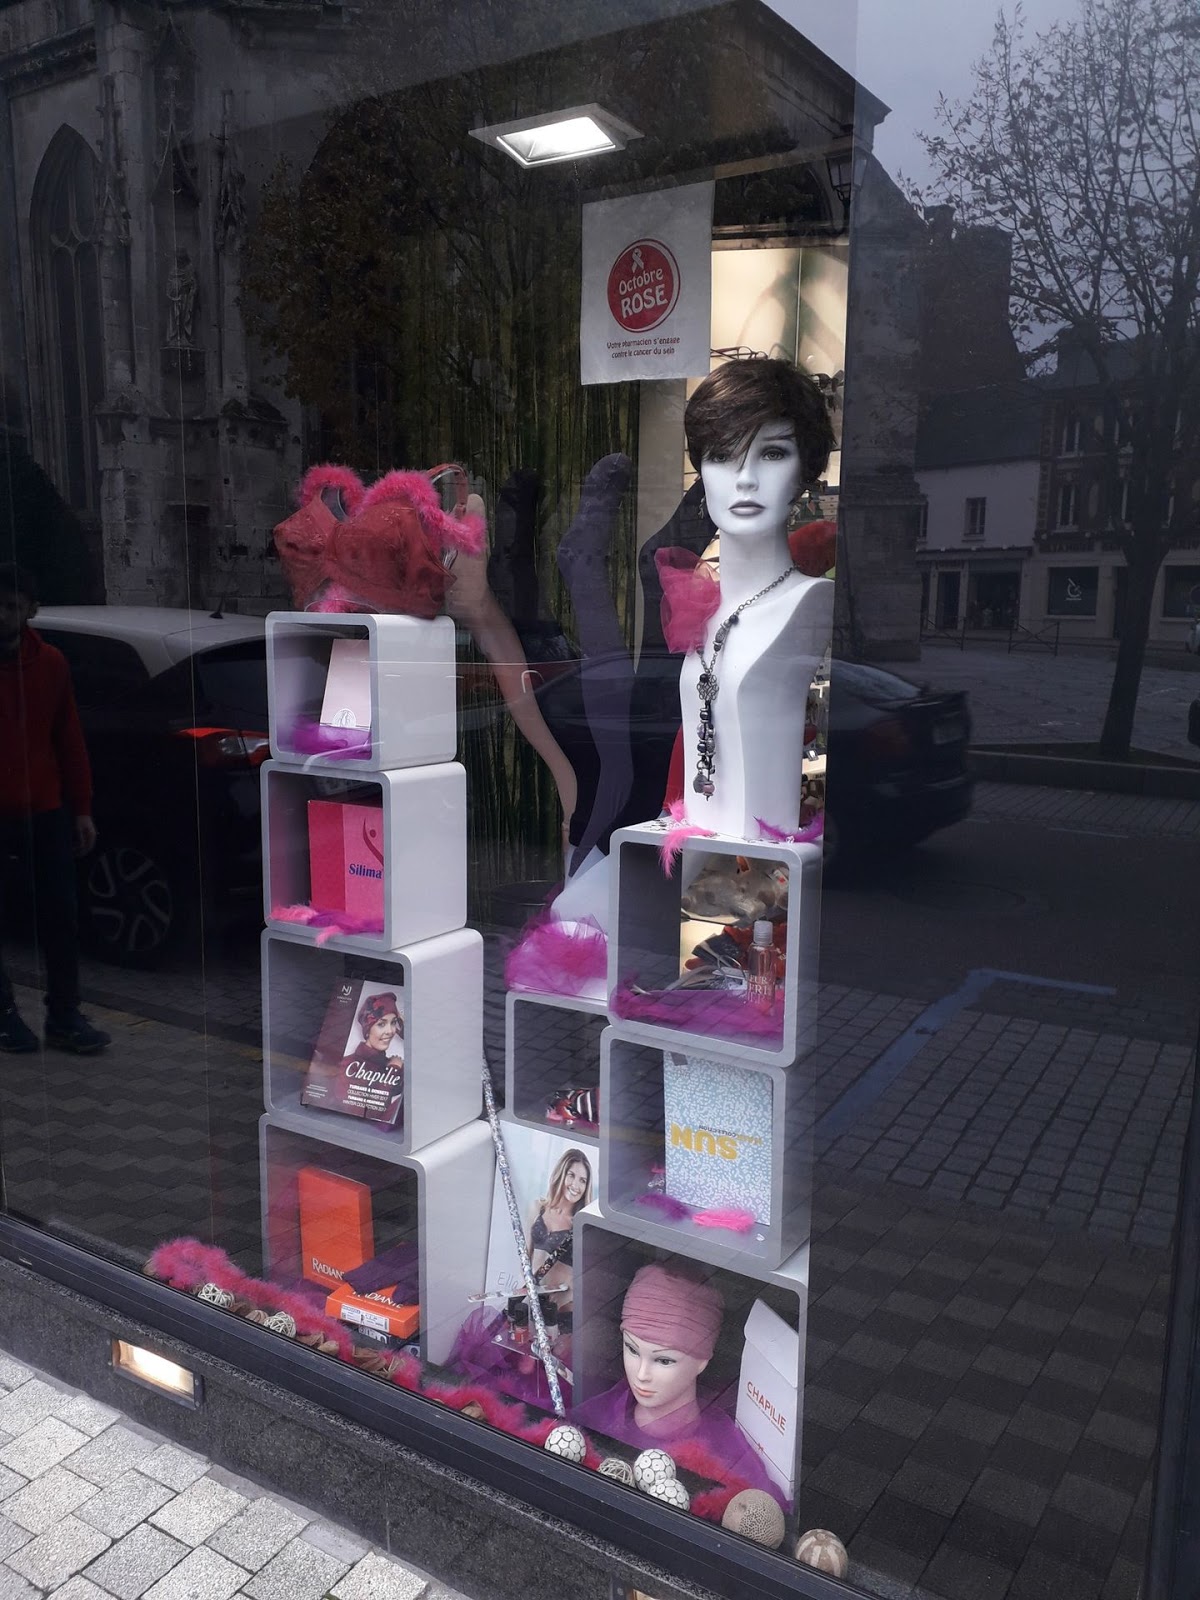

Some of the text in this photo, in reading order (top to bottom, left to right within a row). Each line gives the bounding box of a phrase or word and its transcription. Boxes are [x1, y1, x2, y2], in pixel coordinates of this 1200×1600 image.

[619, 268, 664, 296] Octobre
[621, 283, 669, 319] ROSE
[606, 341, 622, 349] Votre
[622, 338, 652, 348] pharmacien
[611, 351, 627, 359] contre
[633, 348, 652, 356] cancer
[653, 347, 662, 355] du
[662, 346, 675, 354] sein
[349, 863, 382, 879] Silima
[345, 1061, 401, 1086] Chapilie
[670, 1121, 738, 1160] SUN
[699, 1125, 736, 1138] COLLECTION
[312, 1257, 345, 1281] RADIAN
[747, 1380, 787, 1431] CHAPILIE
